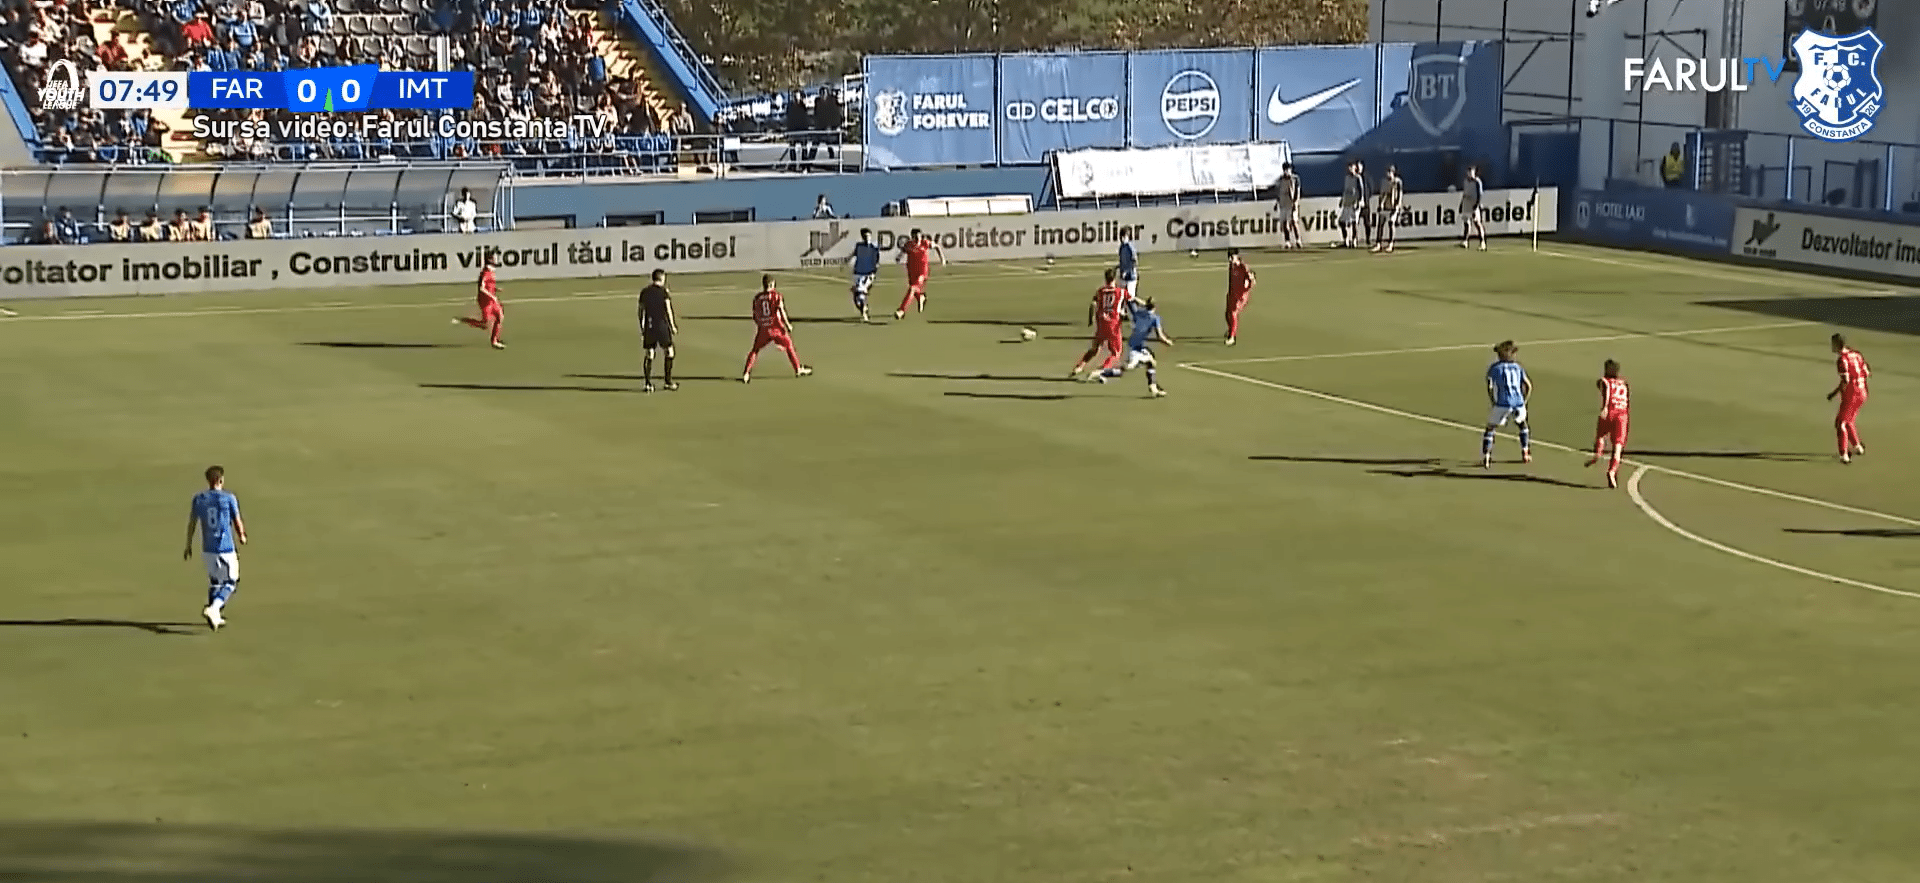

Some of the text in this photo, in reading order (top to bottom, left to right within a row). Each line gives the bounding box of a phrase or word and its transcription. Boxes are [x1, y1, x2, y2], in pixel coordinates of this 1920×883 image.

[1421, 74, 1454, 99] BT
[912, 93, 967, 110] FARUL
[1041, 98, 1119, 122] CELCO
[1165, 97, 1216, 112] PEPSI
[912, 112, 990, 130] FOREVER
[878, 225, 1026, 251] Devoltator
[1436, 204, 1455, 226] la
[1802, 226, 1920, 264] Dezvoltator im
[0, 259, 112, 285] oltator
[123, 254, 262, 281] imobiliar
[289, 248, 448, 275] Construim
[567, 240, 612, 265] tău
[622, 239, 645, 262] la
[653, 235, 736, 260] cheie!
[206, 506, 219, 529] 8
